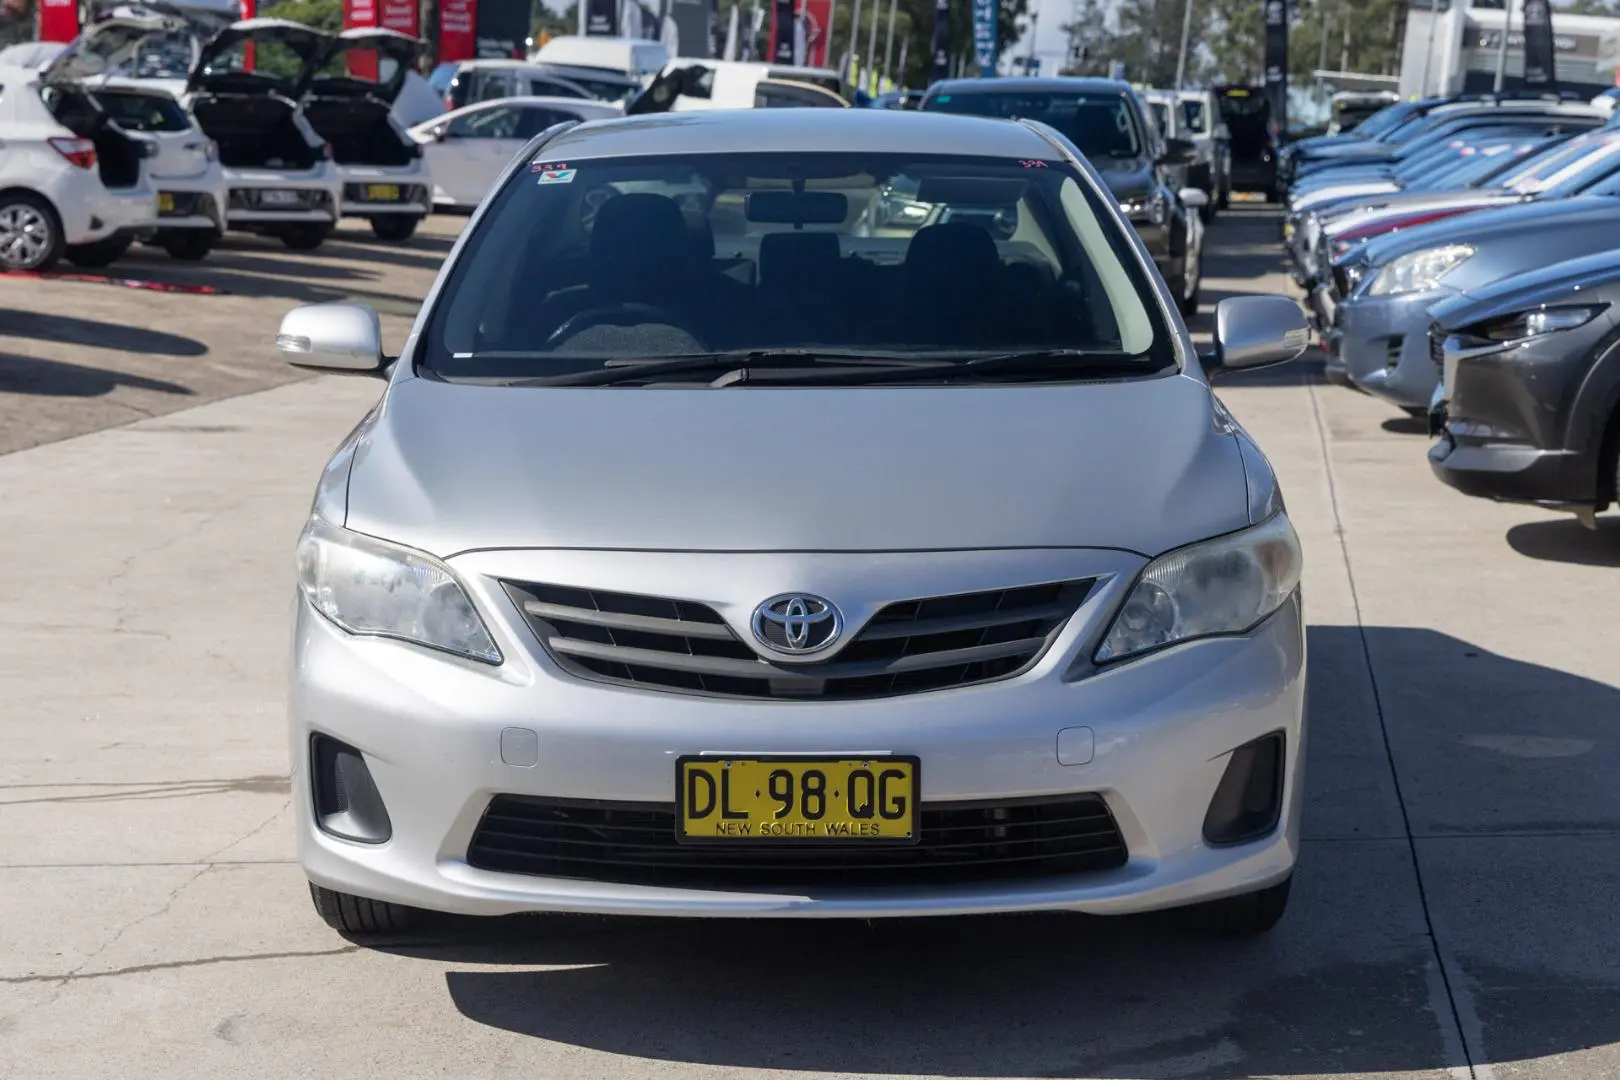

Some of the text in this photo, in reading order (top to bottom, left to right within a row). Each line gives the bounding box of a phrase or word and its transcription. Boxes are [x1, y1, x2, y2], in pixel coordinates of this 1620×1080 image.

[716, 822, 880, 836] NEW SOUTH WALES
